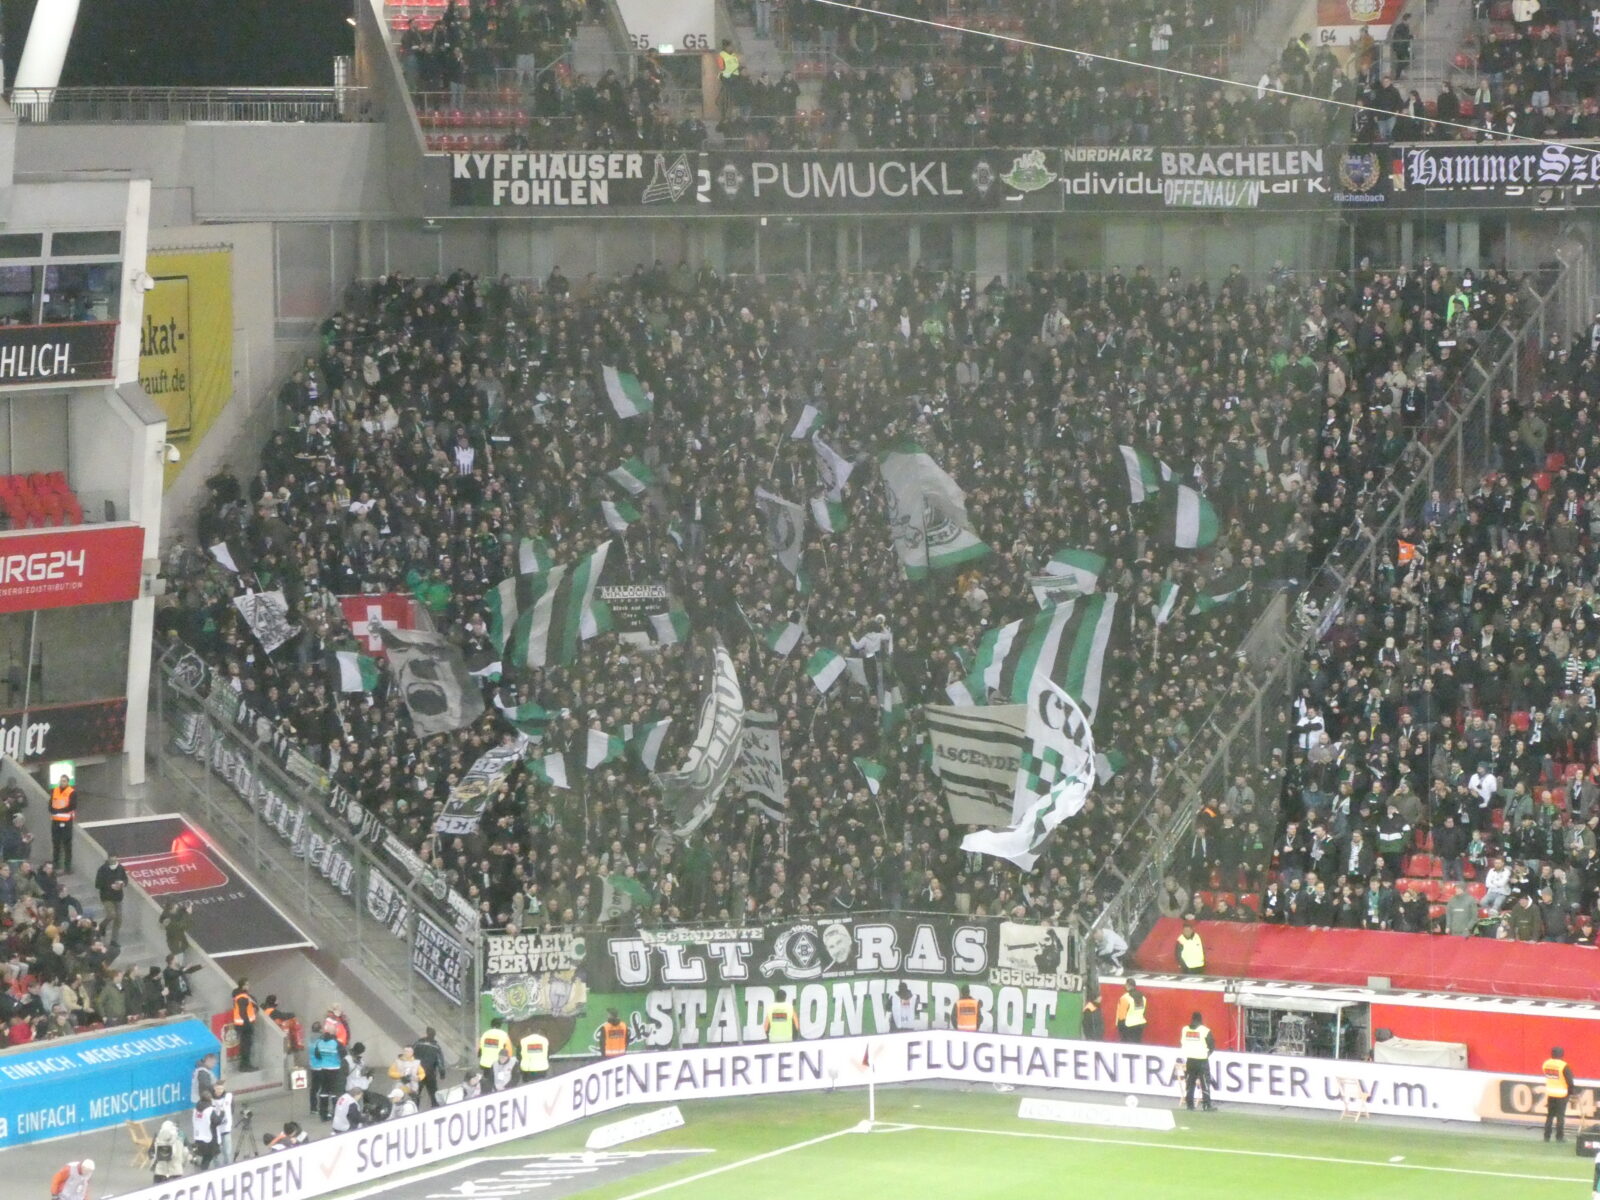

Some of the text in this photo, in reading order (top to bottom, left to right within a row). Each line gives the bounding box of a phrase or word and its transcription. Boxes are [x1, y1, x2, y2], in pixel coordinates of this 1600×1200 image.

[682, 33, 709, 50] G5
[1320, 29, 1337, 42] G4
[453, 152, 644, 180] KYFFHÄUSER
[1063, 149, 1154, 163] NORDHARZ
[1160, 149, 1325, 177] BRACHELEN
[1407, 149, 1536, 186] Hammer
[492, 180, 610, 206] FOHLEN
[751, 160, 963, 198] PUMUCKL
[0, 342, 76, 378] HLICH.
[487, 933, 574, 957] BEGLEIT
[638, 927, 764, 946] ASCENDENTE
[486, 951, 572, 975] SERVICE
[78, 1032, 193, 1065] MENSCHLICH.
[572, 1049, 823, 1110] BOTENFAHRTEN
[89, 1081, 186, 1121] MENSCHLICH.
[357, 1095, 528, 1174] SCHULTOUREN
